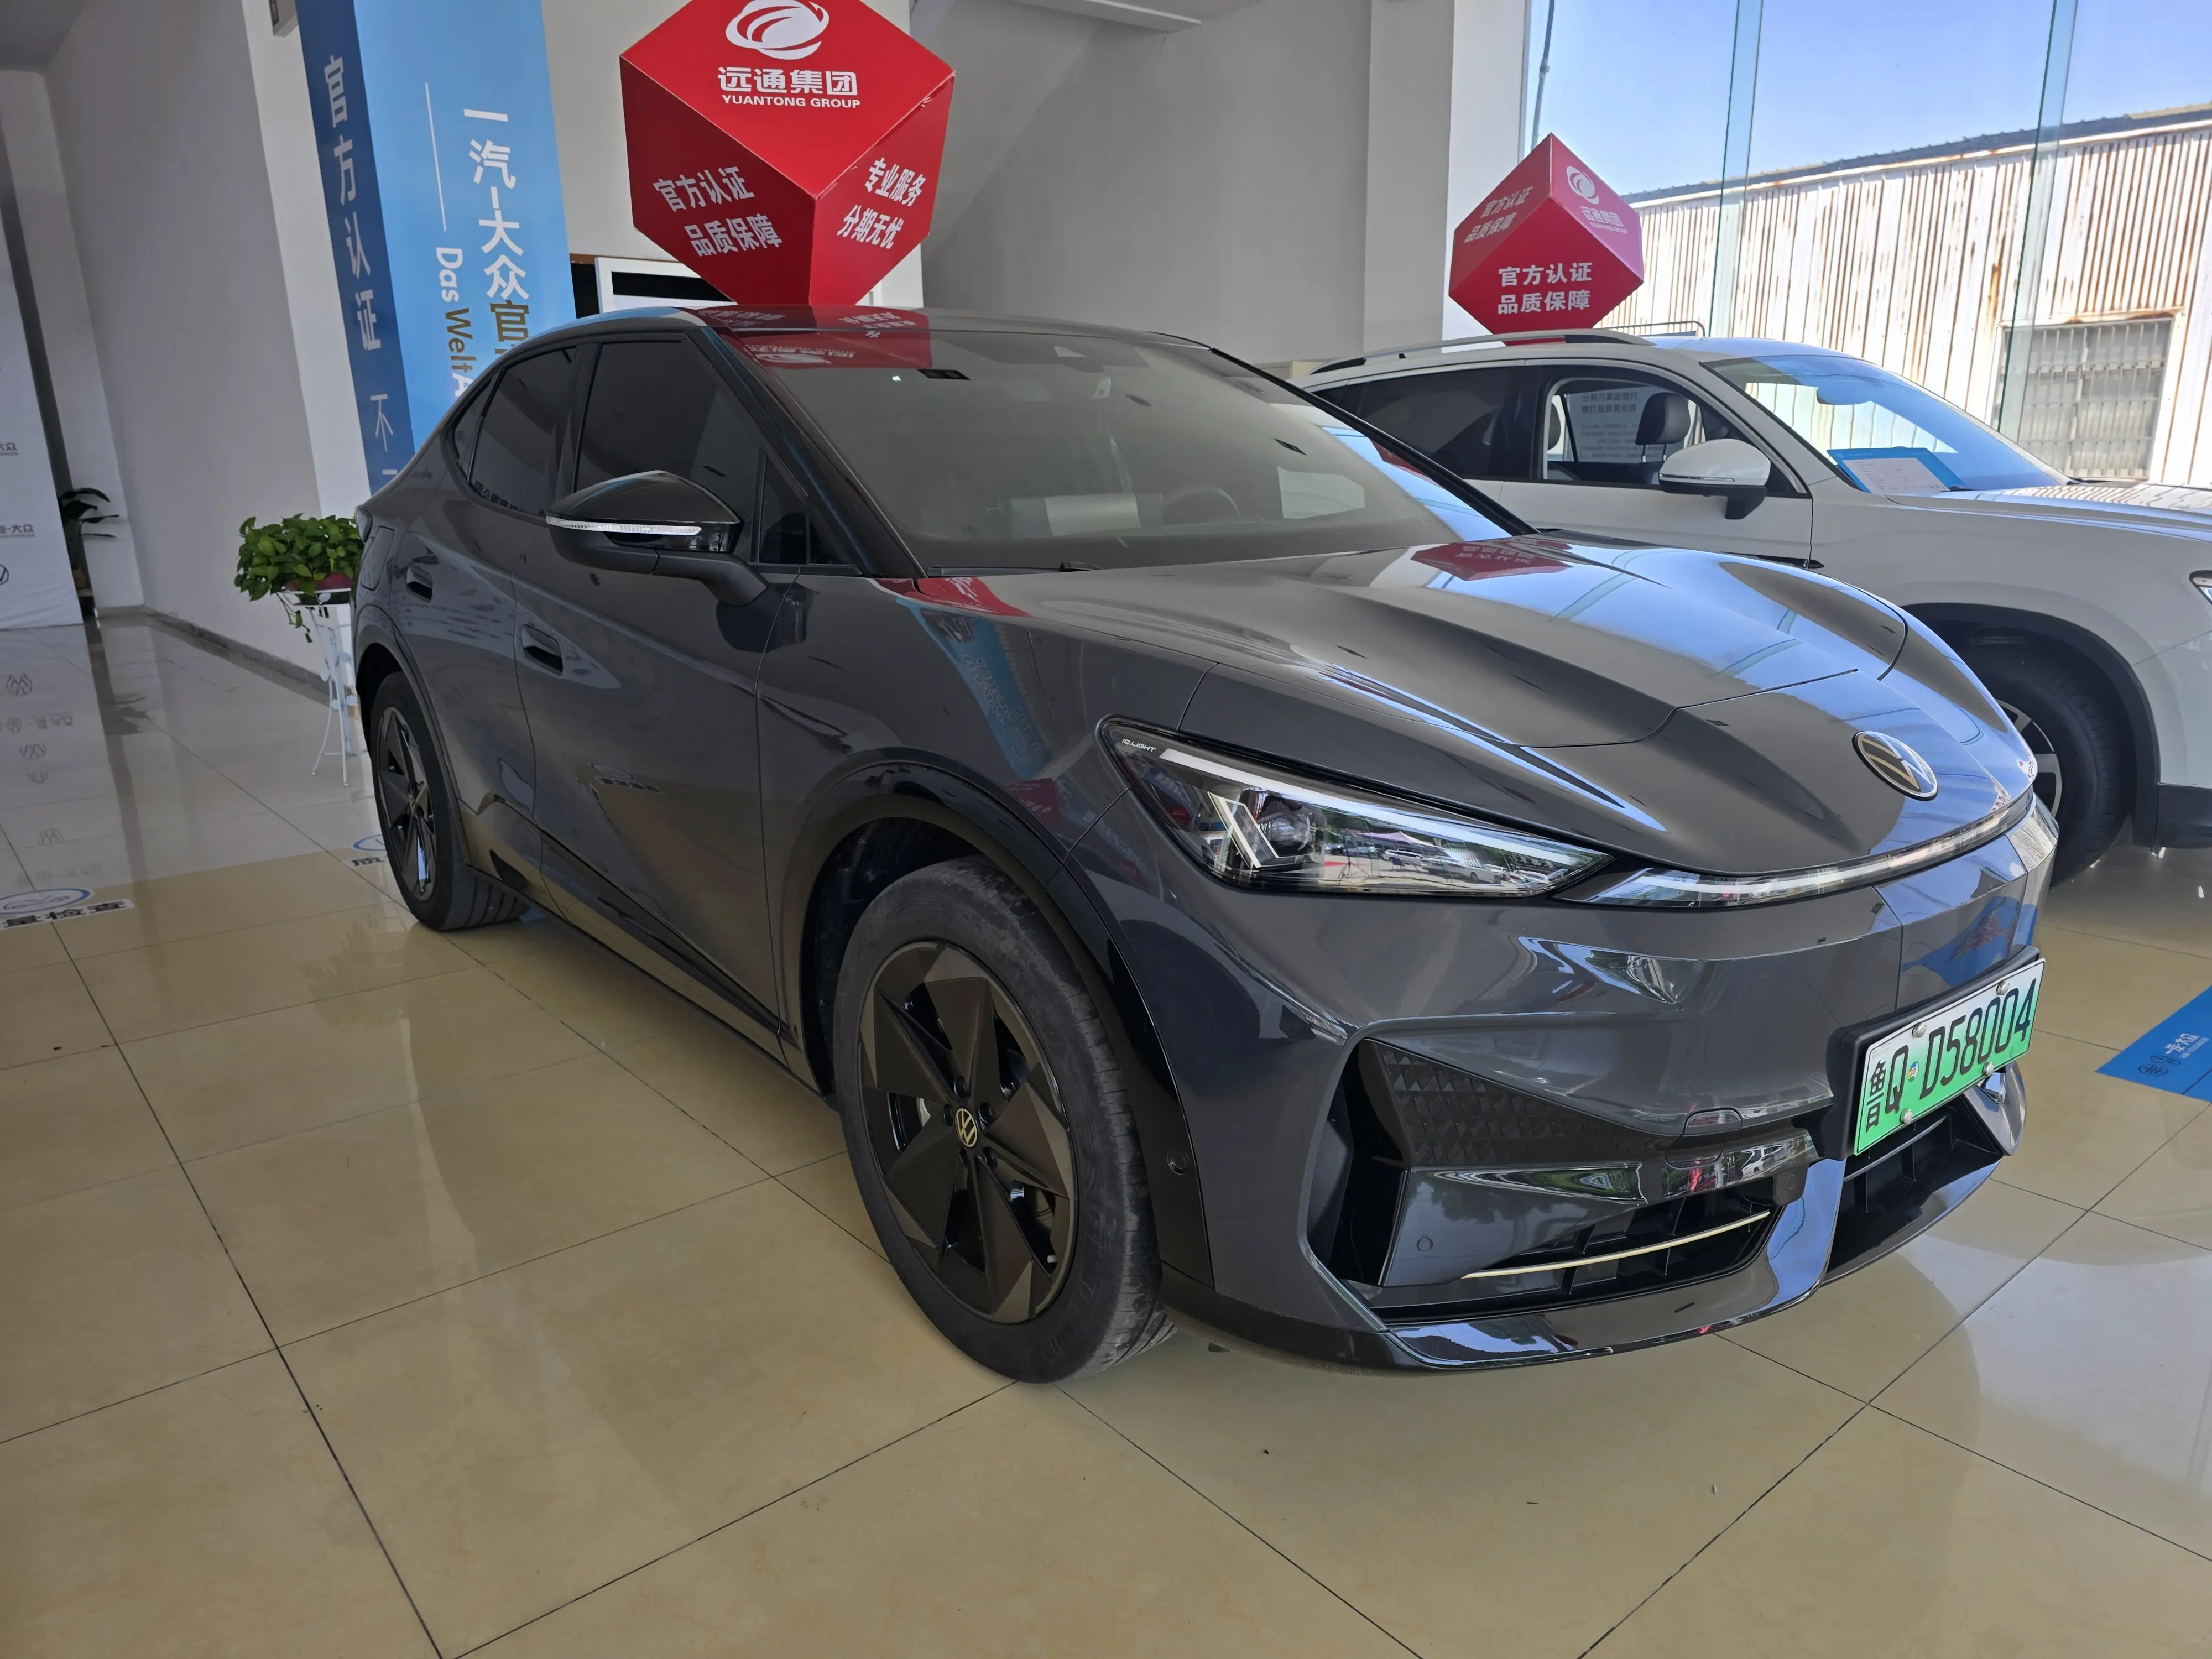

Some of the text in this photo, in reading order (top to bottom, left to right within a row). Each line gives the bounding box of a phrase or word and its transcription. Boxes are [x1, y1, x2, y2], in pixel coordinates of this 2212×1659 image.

[717, 67, 858, 96] 远通集团
[722, 95, 860, 108] YUANTONG GROUP
[653, 166, 755, 212] 官方认证
[864, 158, 926, 207] 专业服务
[324, 55, 382, 351] 官方认证
[1480, 186, 1534, 219] 官方认证
[1579, 206, 1624, 227] 远通集团
[684, 213, 782, 257] 品质保障
[837, 205, 904, 249] 分期无忧
[436, 247, 463, 302] Das
[1498, 262, 1593, 287] 官方认证
[1498, 290, 1591, 315] 品质保障
[1121, 738, 1156, 752] IQ.LIGHT
